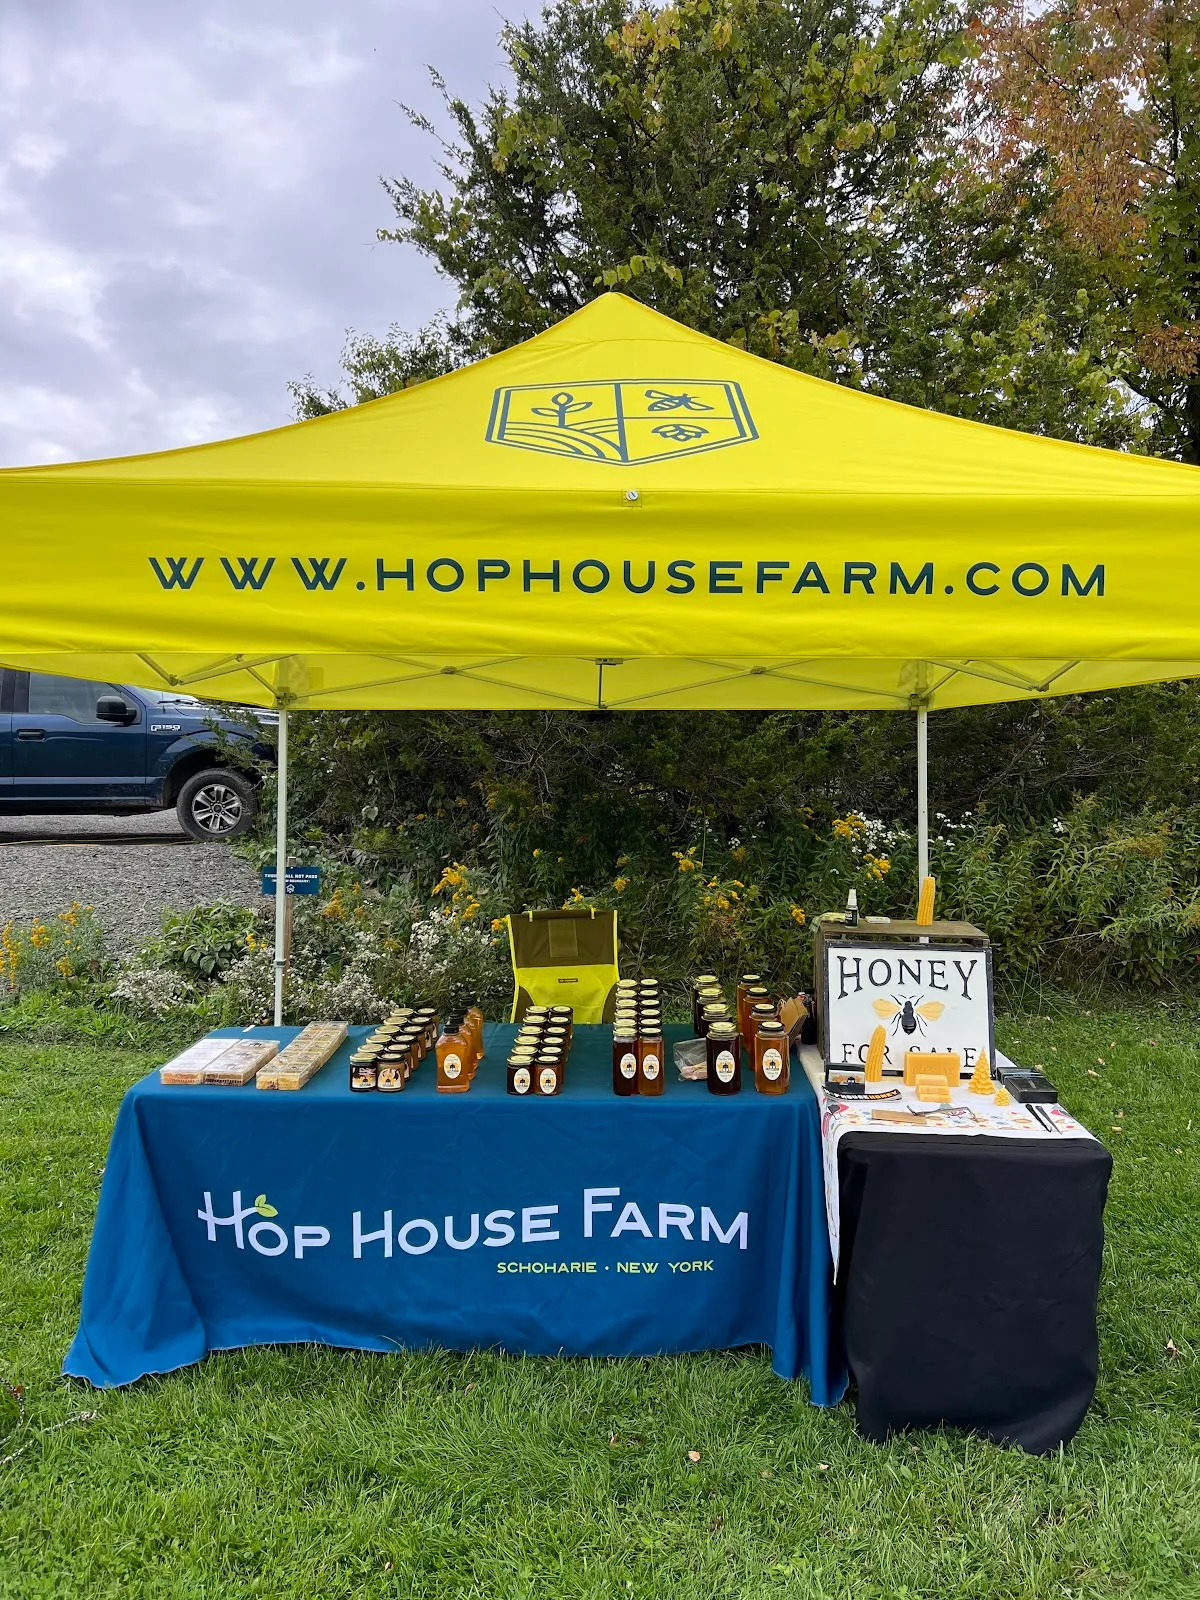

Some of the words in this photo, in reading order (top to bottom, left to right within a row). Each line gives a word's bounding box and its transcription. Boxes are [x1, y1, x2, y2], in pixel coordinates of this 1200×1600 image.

[148, 557, 1105, 596] WWW.HOPHOUSEFARM.COM
[837, 956, 978, 1000] HONEY
[198, 1190, 331, 1259] HOP
[353, 1205, 560, 1259] HOUSE
[584, 1187, 749, 1250] FARM
[497, 1261, 597, 1274] SCHOHARIE
[617, 1262, 659, 1274] NEW
[668, 1260, 714, 1274] YORK
